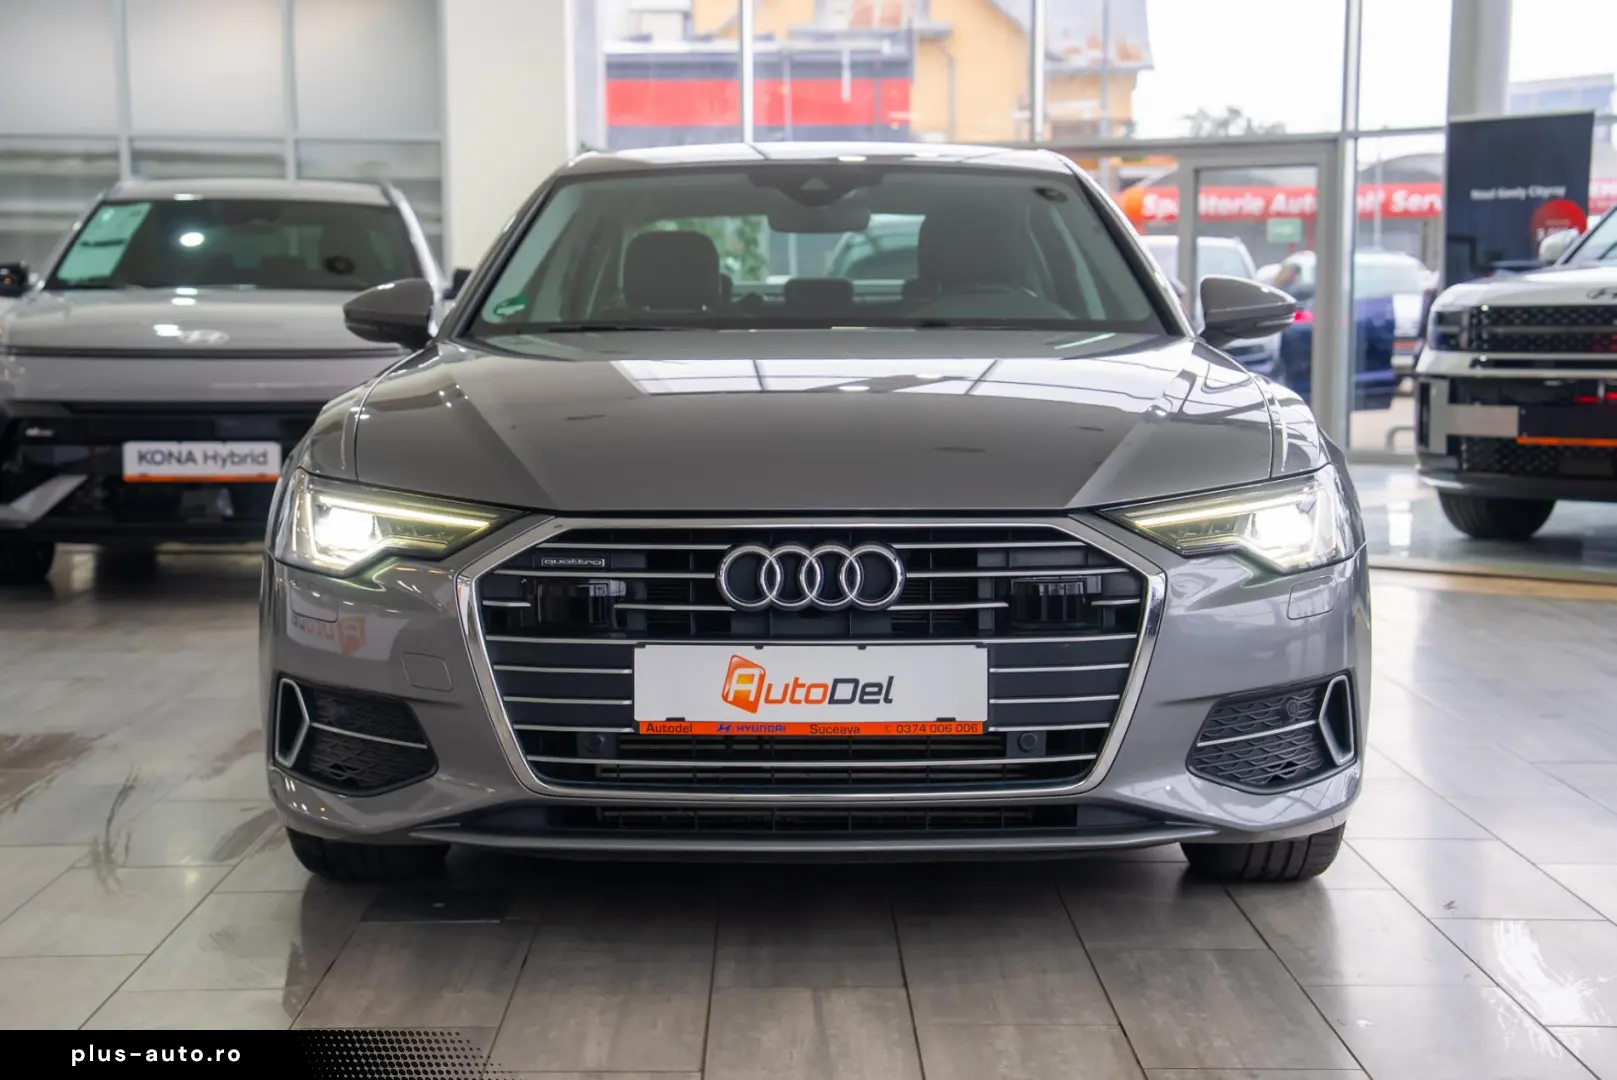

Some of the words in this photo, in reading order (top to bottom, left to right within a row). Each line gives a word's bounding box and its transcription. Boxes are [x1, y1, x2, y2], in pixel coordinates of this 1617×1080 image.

[138, 450, 197, 466] KONA
[204, 449, 268, 468] Hybrid
[542, 558, 603, 567] quattro
[722, 654, 894, 713] AutoDel
[646, 723, 693, 733] Autodel
[736, 724, 786, 733] HYUNDAI
[810, 724, 861, 734] Suceava
[896, 724, 926, 733] 0374
[930, 724, 952, 733] 006
[956, 724, 978, 733] 006
